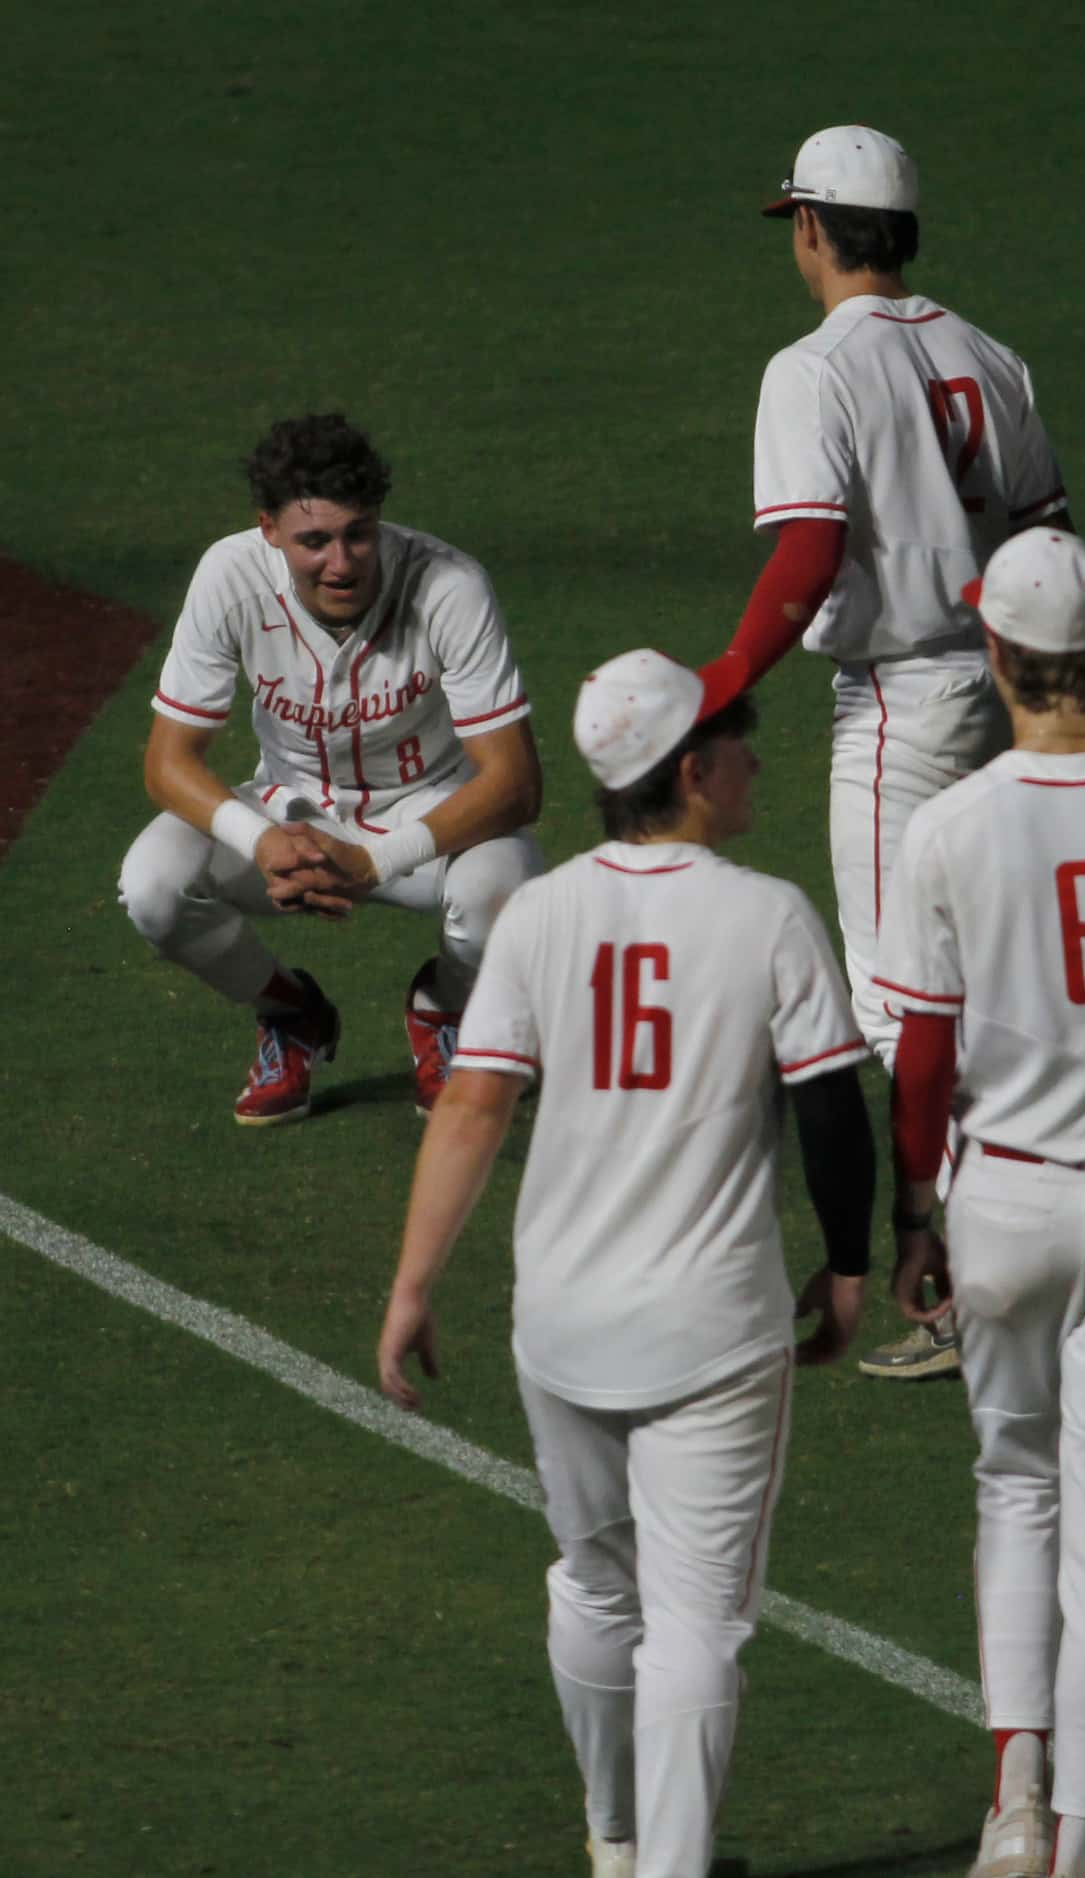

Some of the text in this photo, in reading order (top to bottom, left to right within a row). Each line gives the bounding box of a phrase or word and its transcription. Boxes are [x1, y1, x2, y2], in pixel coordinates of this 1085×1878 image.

[254, 671, 433, 741] Grapevine
[396, 735, 425, 785] 8
[590, 942, 672, 1091] 16
